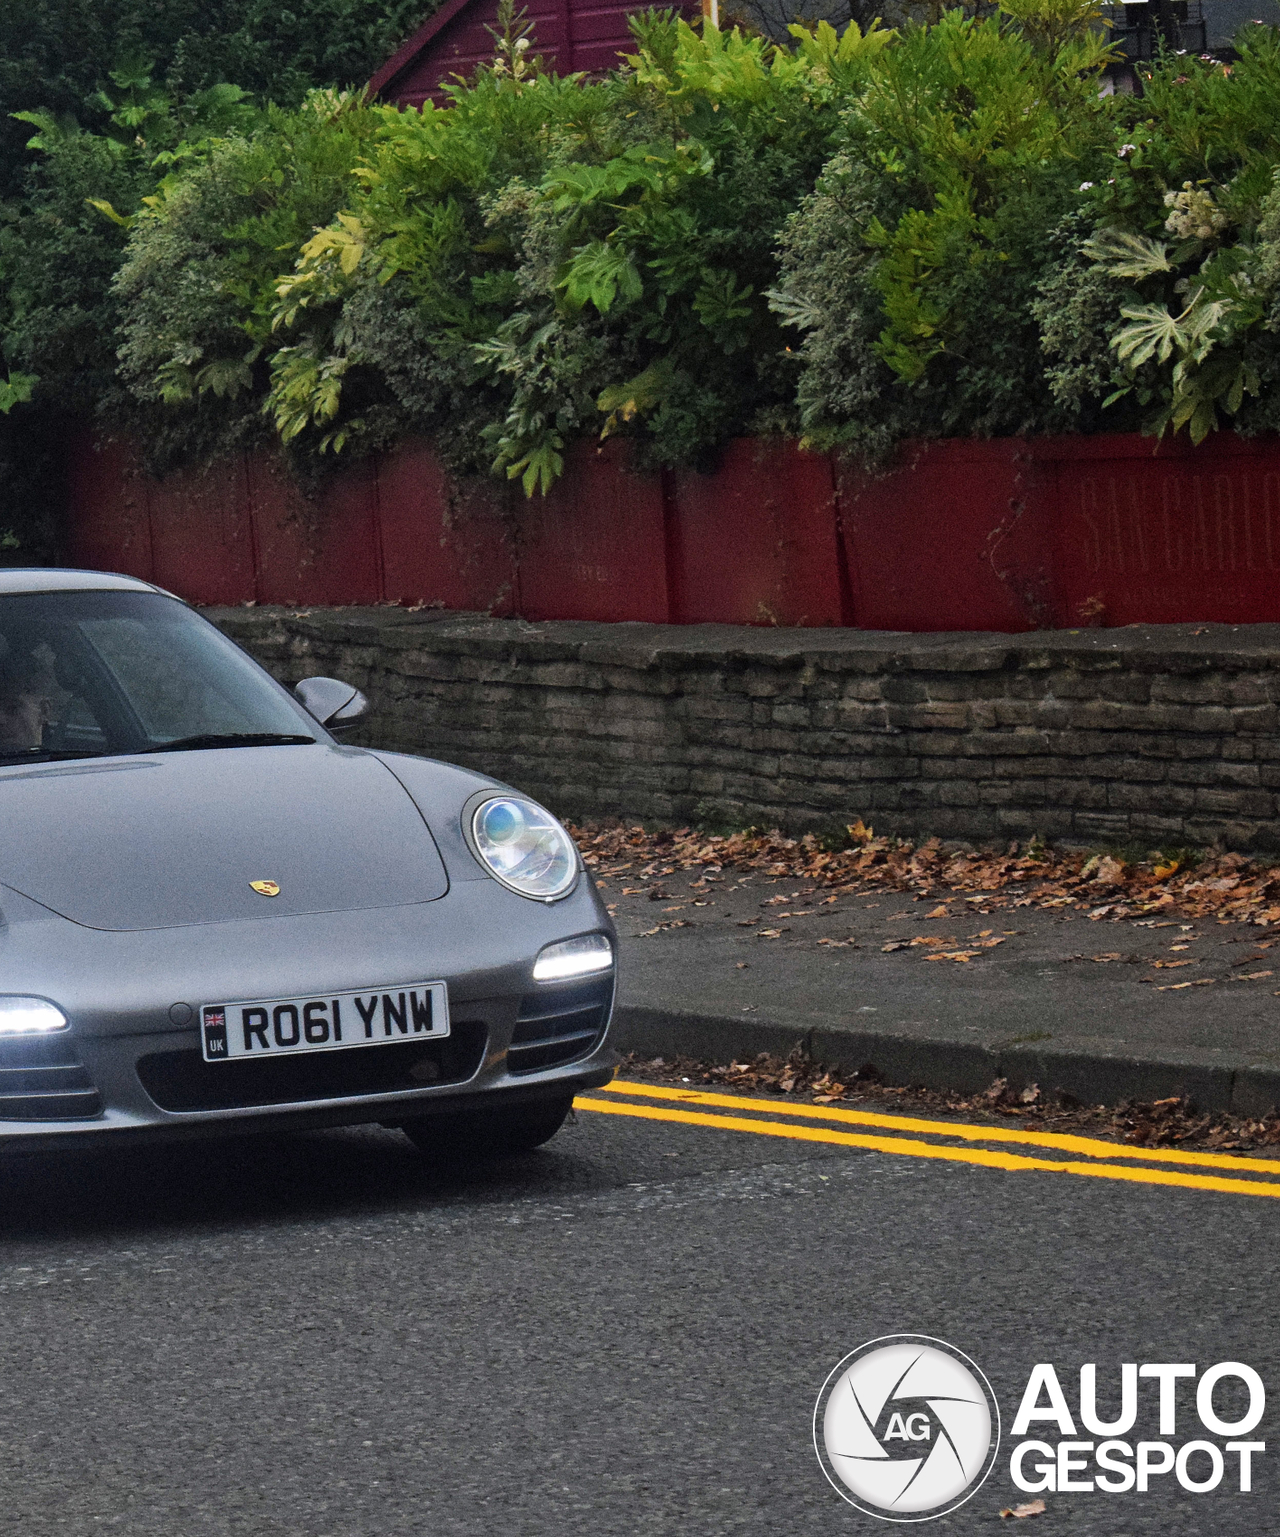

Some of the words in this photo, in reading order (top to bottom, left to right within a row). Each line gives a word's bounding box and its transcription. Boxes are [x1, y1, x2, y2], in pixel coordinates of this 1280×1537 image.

[241, 999, 342, 1050] RO61
[354, 989, 433, 1038] YNW
[210, 1038, 224, 1052] UK
